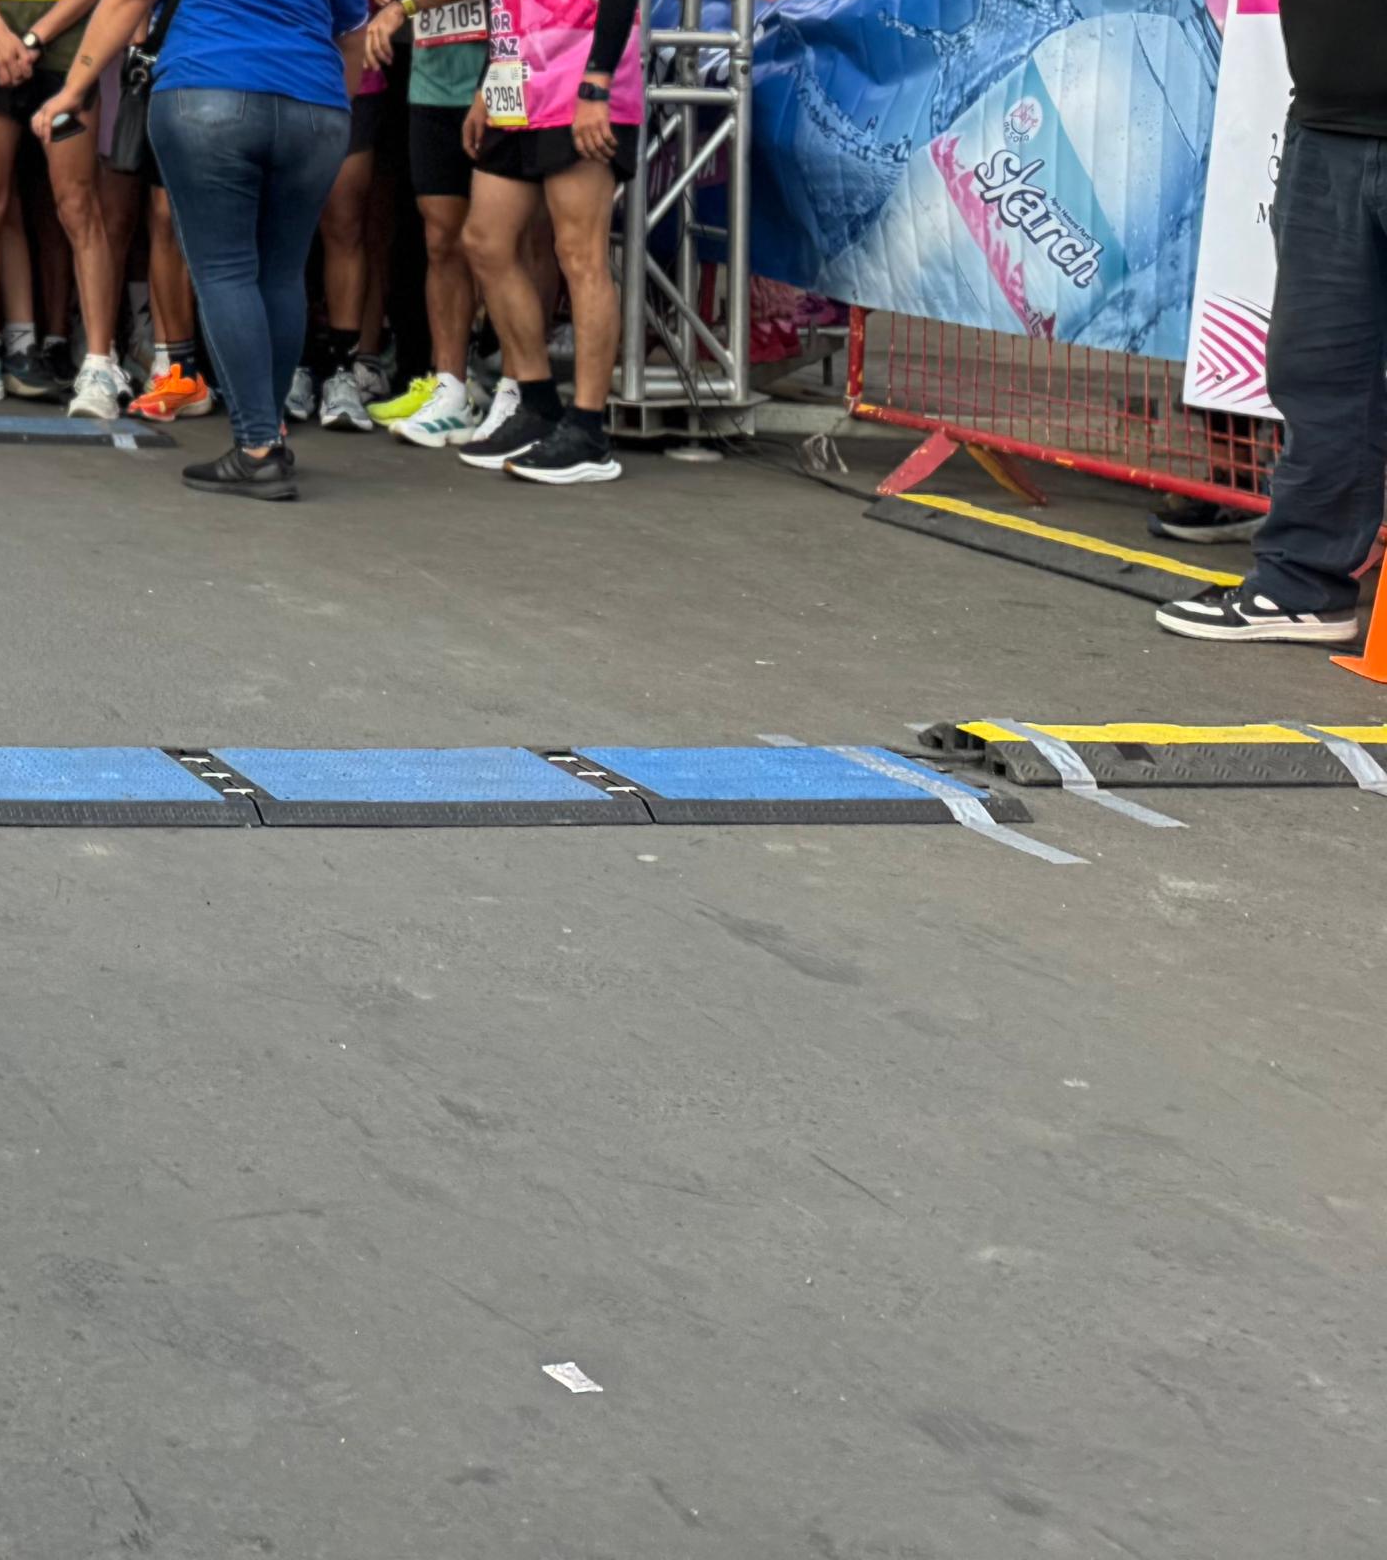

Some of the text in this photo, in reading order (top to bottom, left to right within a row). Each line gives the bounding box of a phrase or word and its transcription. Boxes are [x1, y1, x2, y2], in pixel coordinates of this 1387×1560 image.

[435, 1, 483, 32] 2105
[495, 85, 523, 112] 2964
[974, 149, 1105, 289] Skarch
